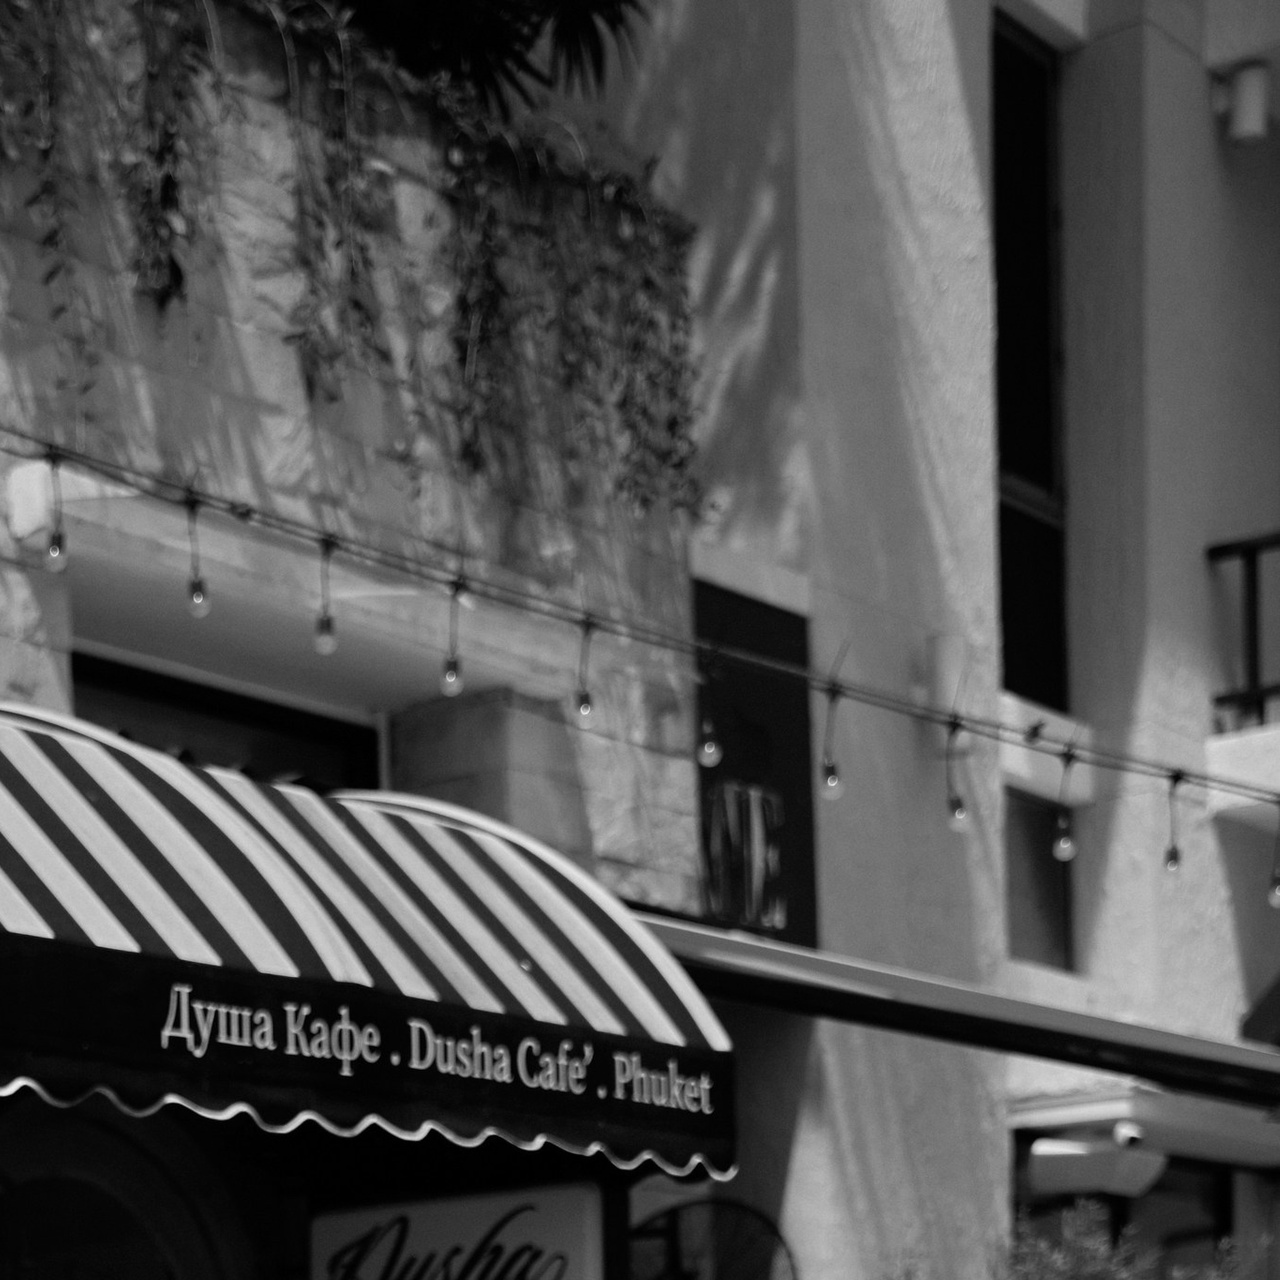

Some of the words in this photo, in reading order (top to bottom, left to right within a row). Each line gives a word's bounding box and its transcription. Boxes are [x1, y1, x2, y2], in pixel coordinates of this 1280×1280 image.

[161, 983, 276, 1057] Душа
[284, 1004, 381, 1077] Кафе
[408, 1016, 513, 1085] Dusha
[613, 1051, 716, 1116] Phuket
